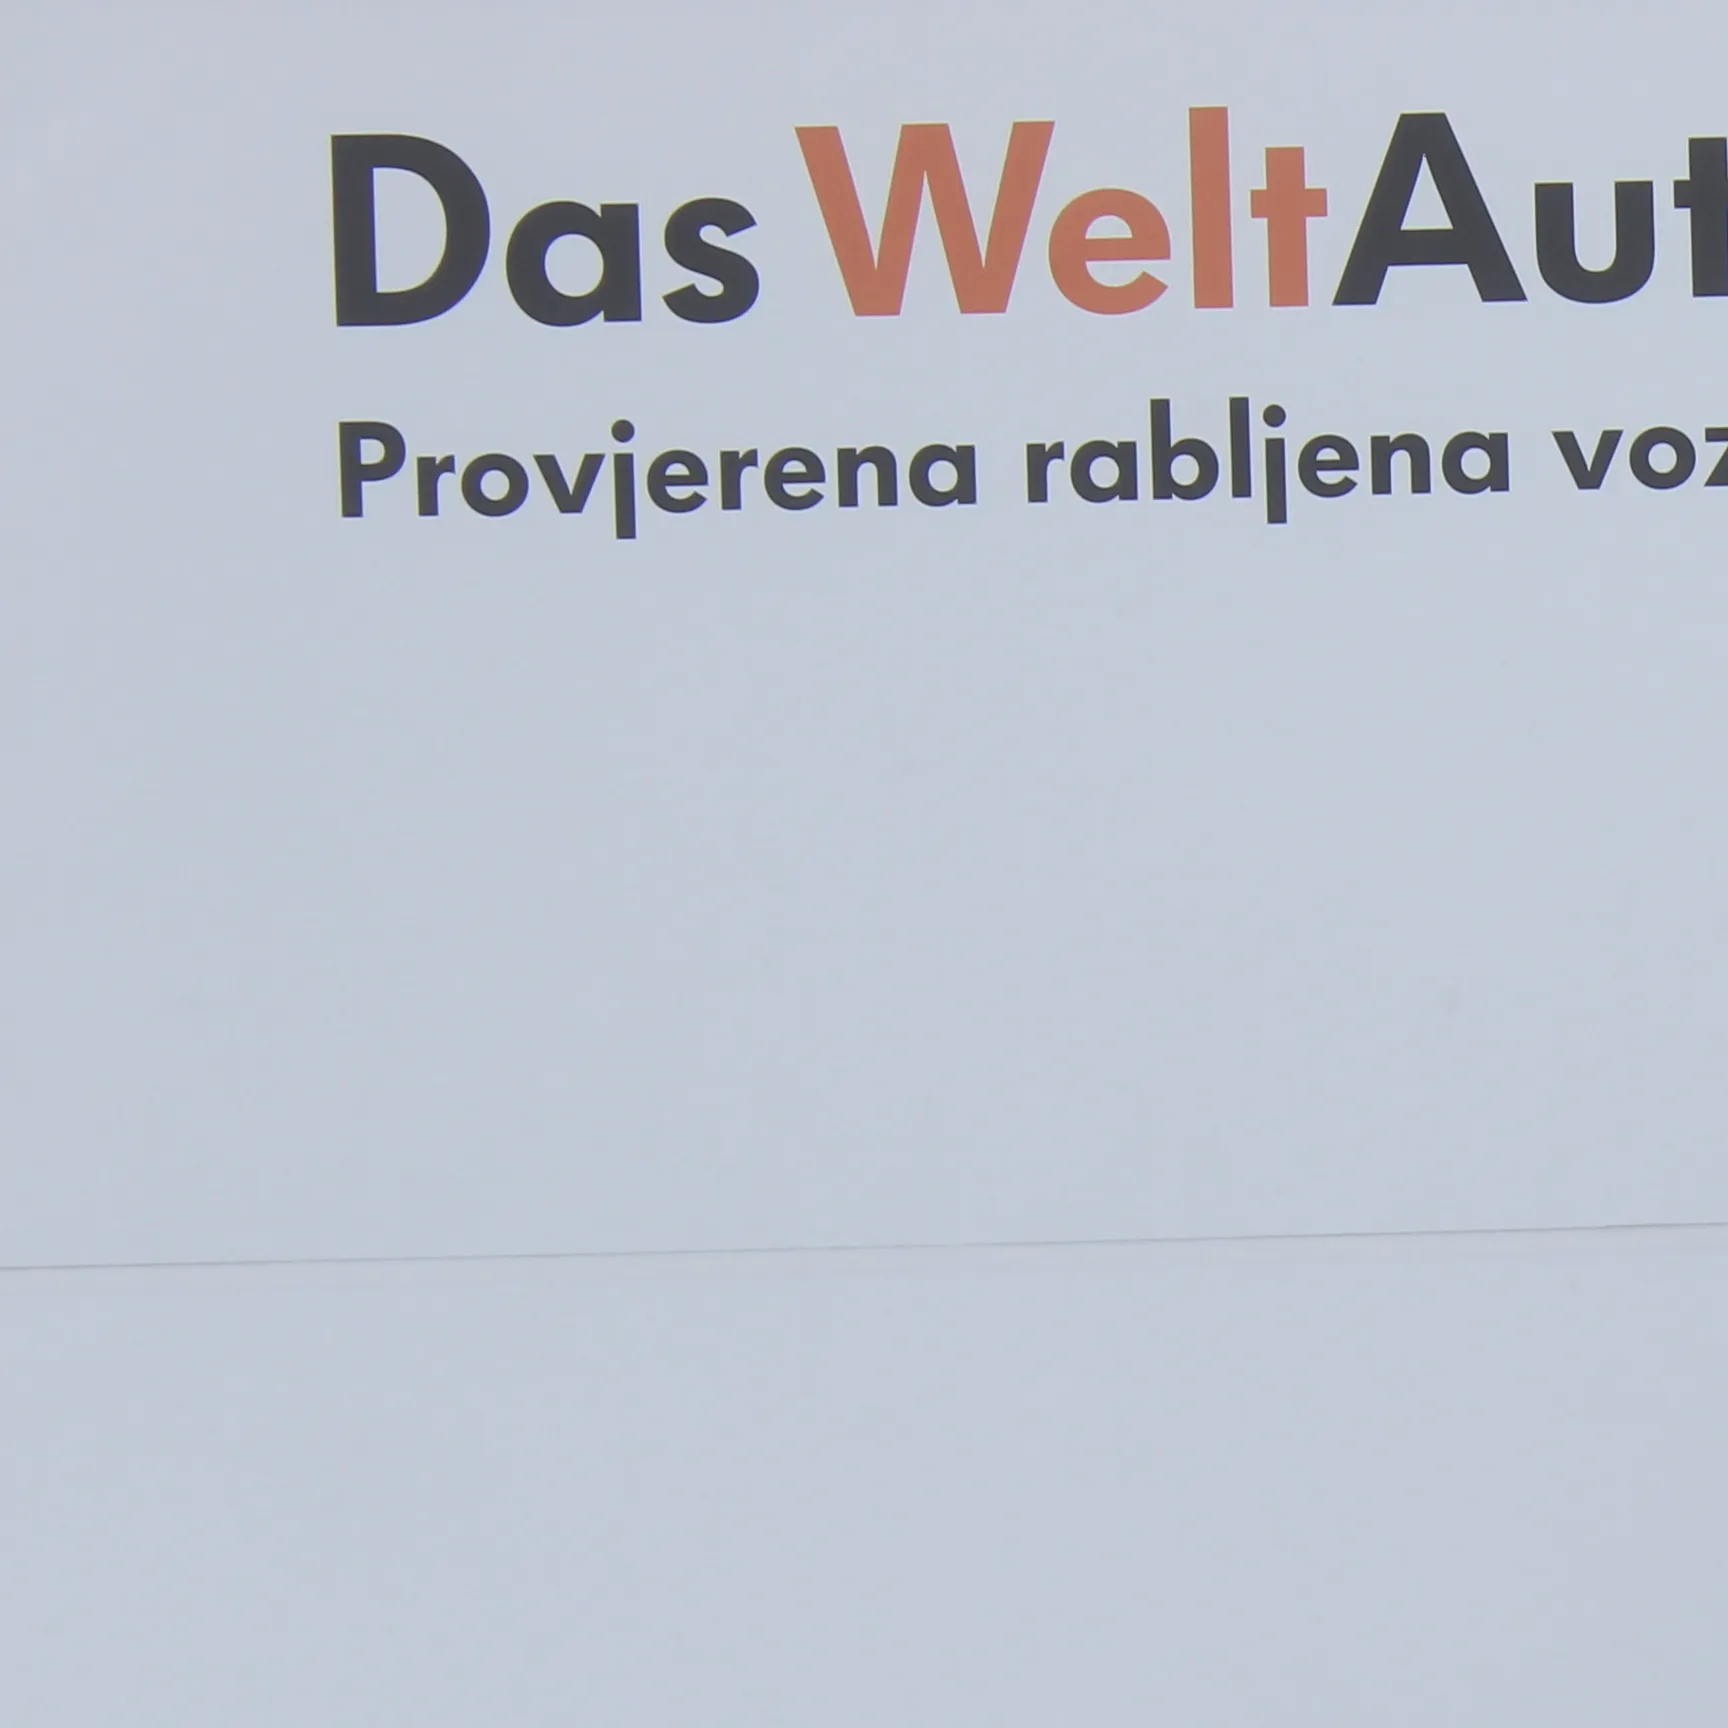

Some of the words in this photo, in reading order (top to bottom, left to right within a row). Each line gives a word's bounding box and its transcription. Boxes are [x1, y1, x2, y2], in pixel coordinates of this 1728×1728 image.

[330, 133, 759, 327] Das
[338, 419, 977, 541] Provjerena
[1026, 398, 1511, 525] rabljena
